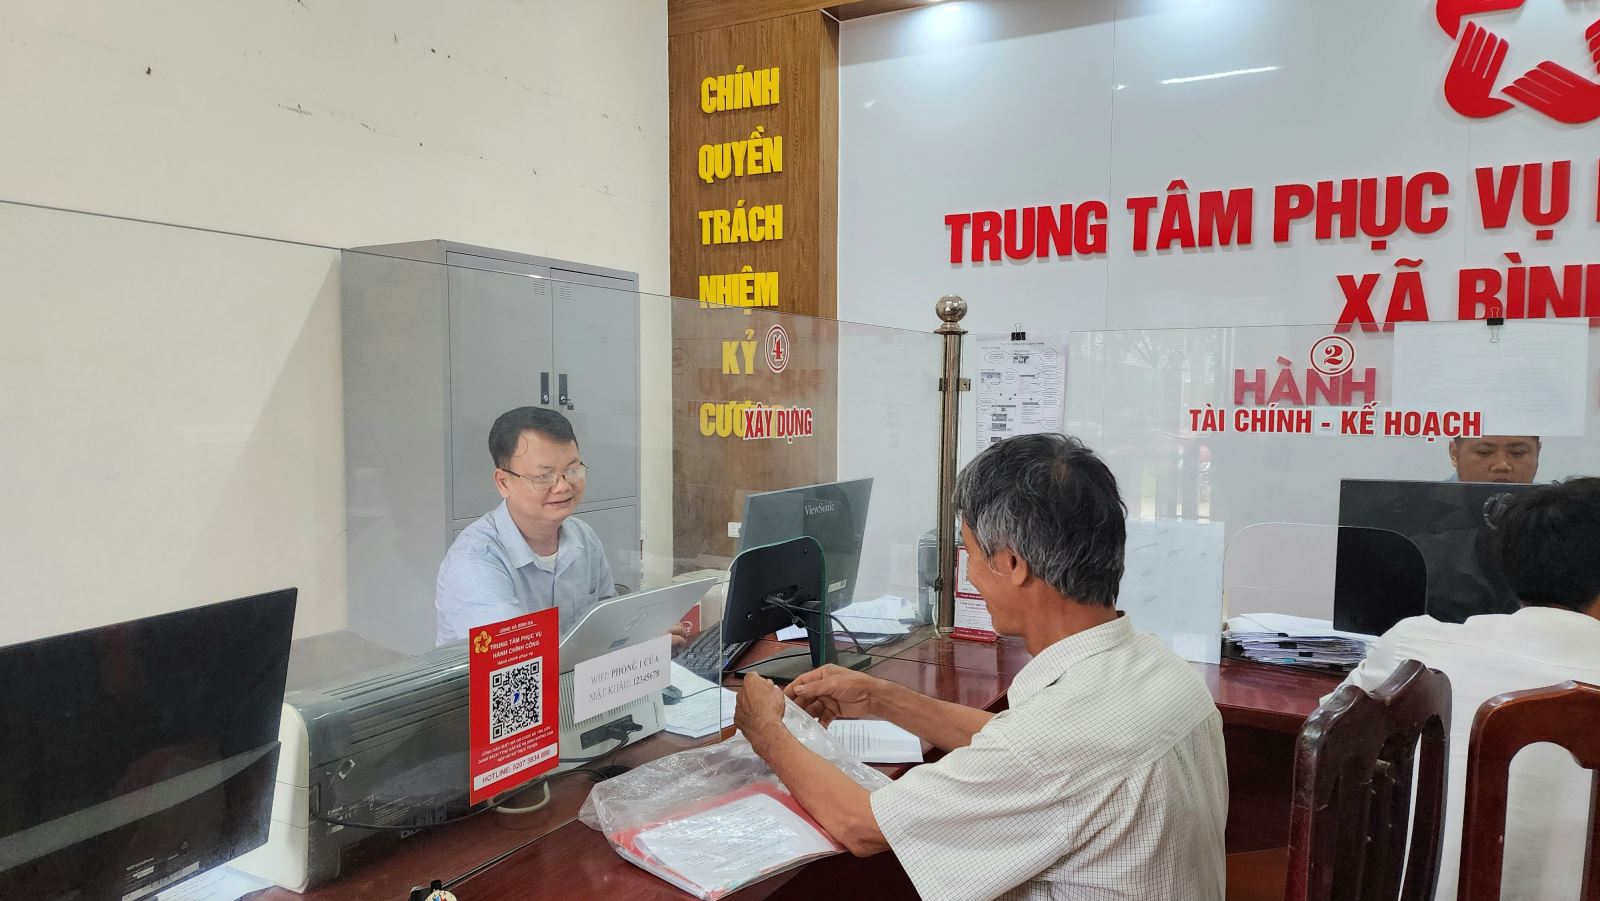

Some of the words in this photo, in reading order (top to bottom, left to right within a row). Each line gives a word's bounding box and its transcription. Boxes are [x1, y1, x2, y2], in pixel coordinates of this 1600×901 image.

[700, 65, 780, 112] CHÍNH
[698, 125, 783, 183] QUYỀN
[699, 204, 783, 246] TRÁCH
[945, 201, 1108, 263] TRUNG
[1127, 180, 1253, 251] TÂM
[1274, 172, 1449, 250] PHỤC
[1476, 161, 1571, 240] VỤ
[699, 265, 779, 314] NHIỆM
[1335, 258, 1429, 333] XÃ
[1458, 252, 1600, 326] BÌN
[722, 329, 758, 374] KỶ
[772, 336, 783, 360] 4
[1325, 345, 1344, 366] 2
[1234, 355, 1376, 404] HÀNH
[744, 403, 773, 439] XÂY
[777, 407, 812, 443] DỰNG
[1189, 403, 1225, 432] TÀI
[1234, 403, 1312, 433] CHÍNH
[1341, 401, 1378, 435] KẾ
[1384, 411, 1481, 442] HOẠCH
[490, 640, 508, 650] TRUNG
[509, 636, 520, 646] TÂM
[520, 632, 534, 642] PHỤC
[535, 630, 543, 638] VỤ
[493, 649, 508, 659] HÀNH
[508, 644, 524, 654] CHÍNH
[525, 640, 540, 648] CÔNG
[482, 766, 512, 784] HOTLINE:
